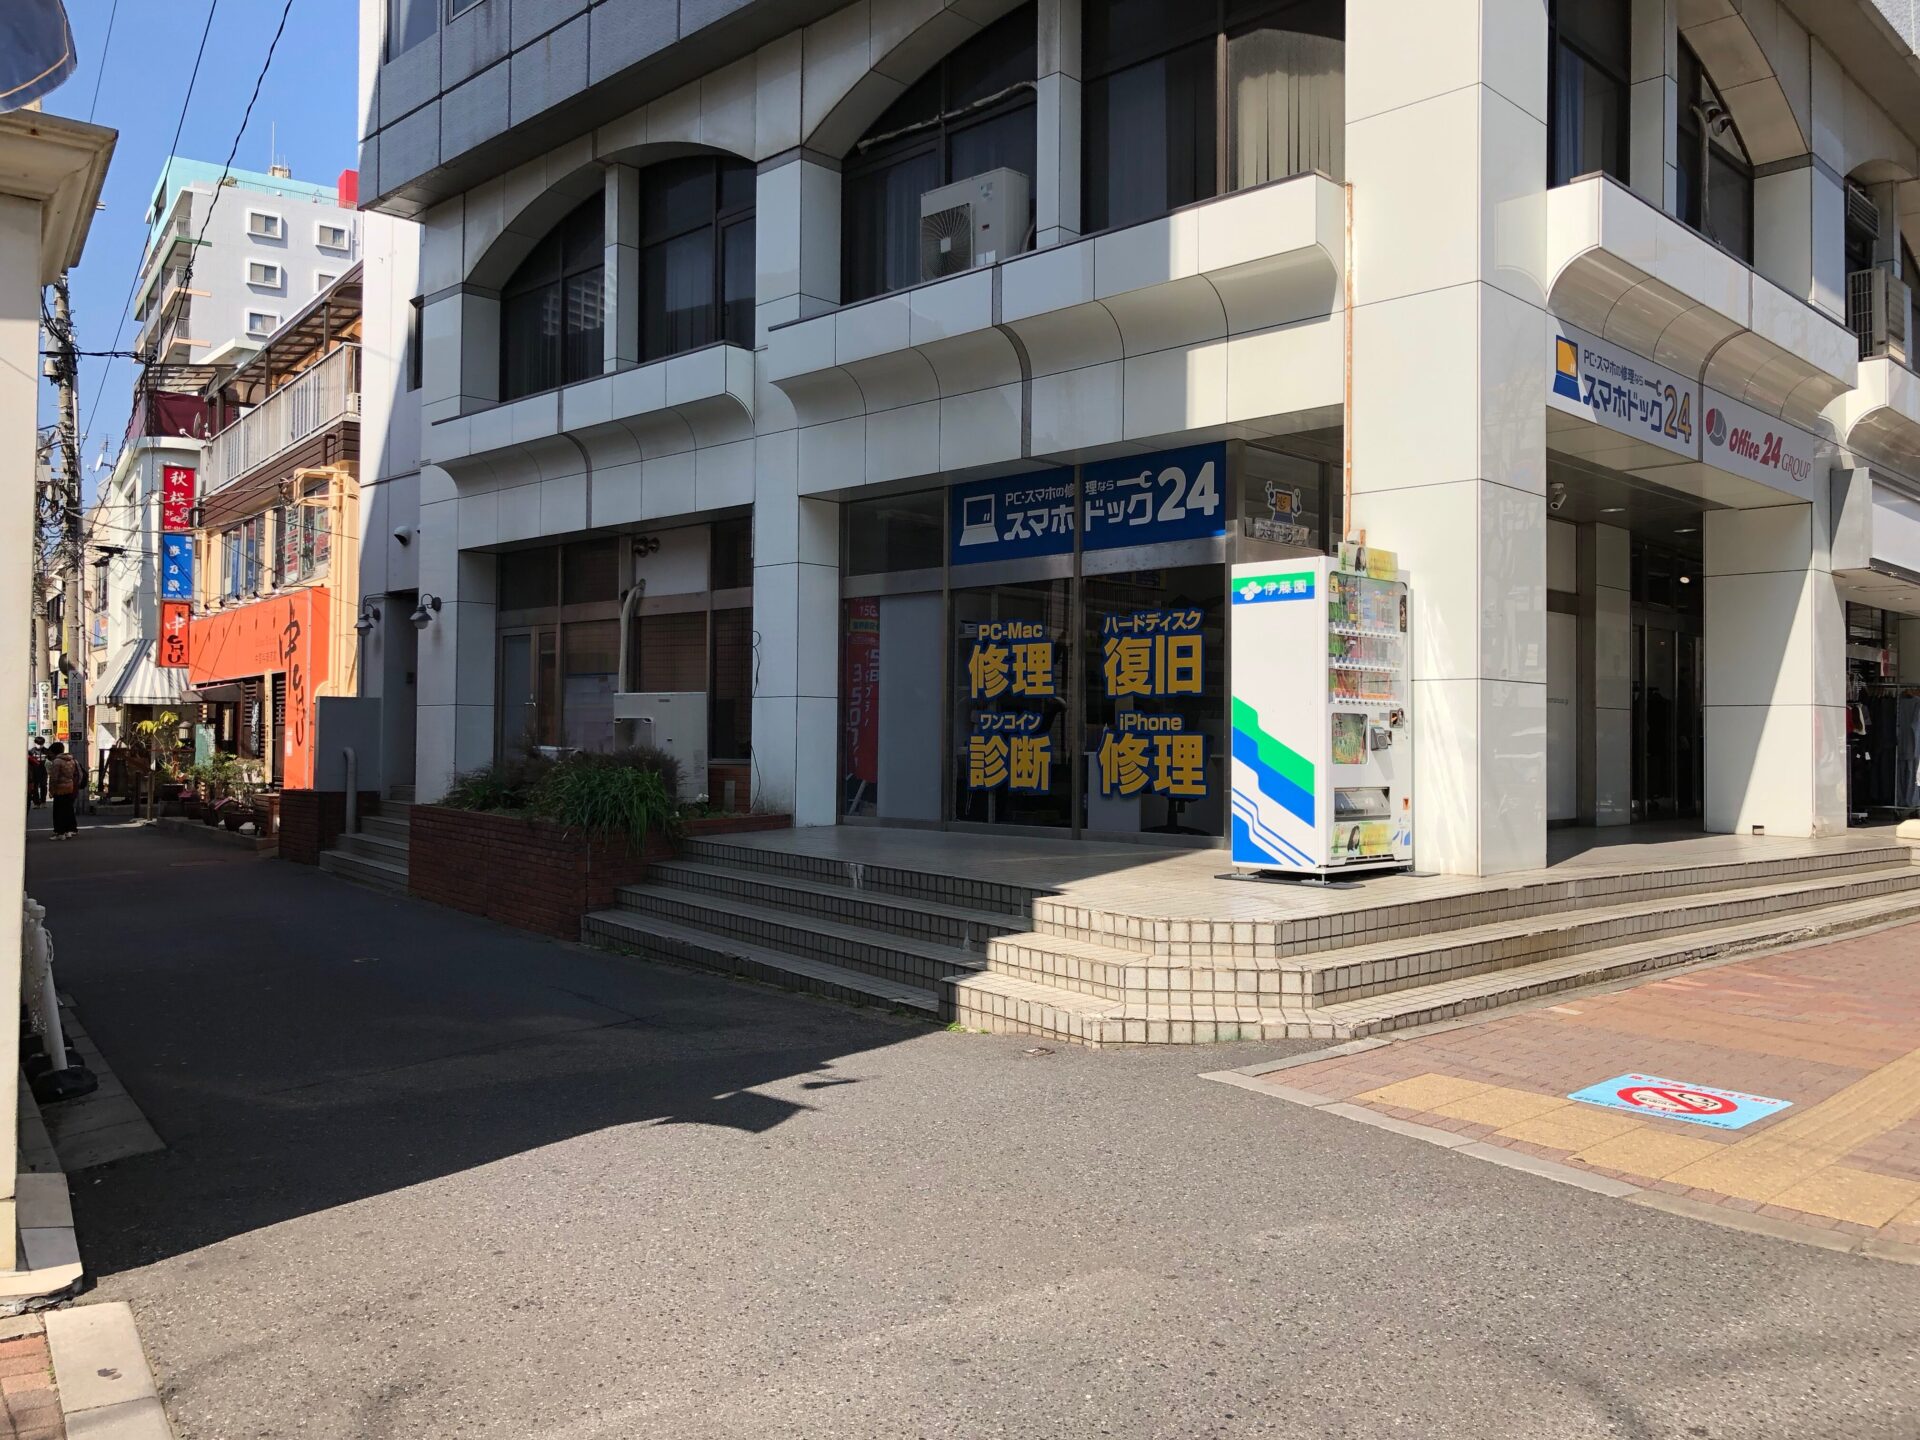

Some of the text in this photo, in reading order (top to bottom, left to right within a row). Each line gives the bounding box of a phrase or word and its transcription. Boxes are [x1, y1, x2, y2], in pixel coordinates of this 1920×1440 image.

[1729, 427, 1811, 482] Office 24 GROUP
[1264, 580, 1307, 597] 伊藤園
[1104, 610, 1202, 635] ハードディスク
[969, 642, 1054, 699] 修理
[1104, 634, 1203, 696] 復旧
[980, 714, 1041, 731] ワンコイン
[1120, 713, 1182, 731] iPhone
[970, 735, 1050, 788] 診断
[1099, 733, 1207, 795] 修理
